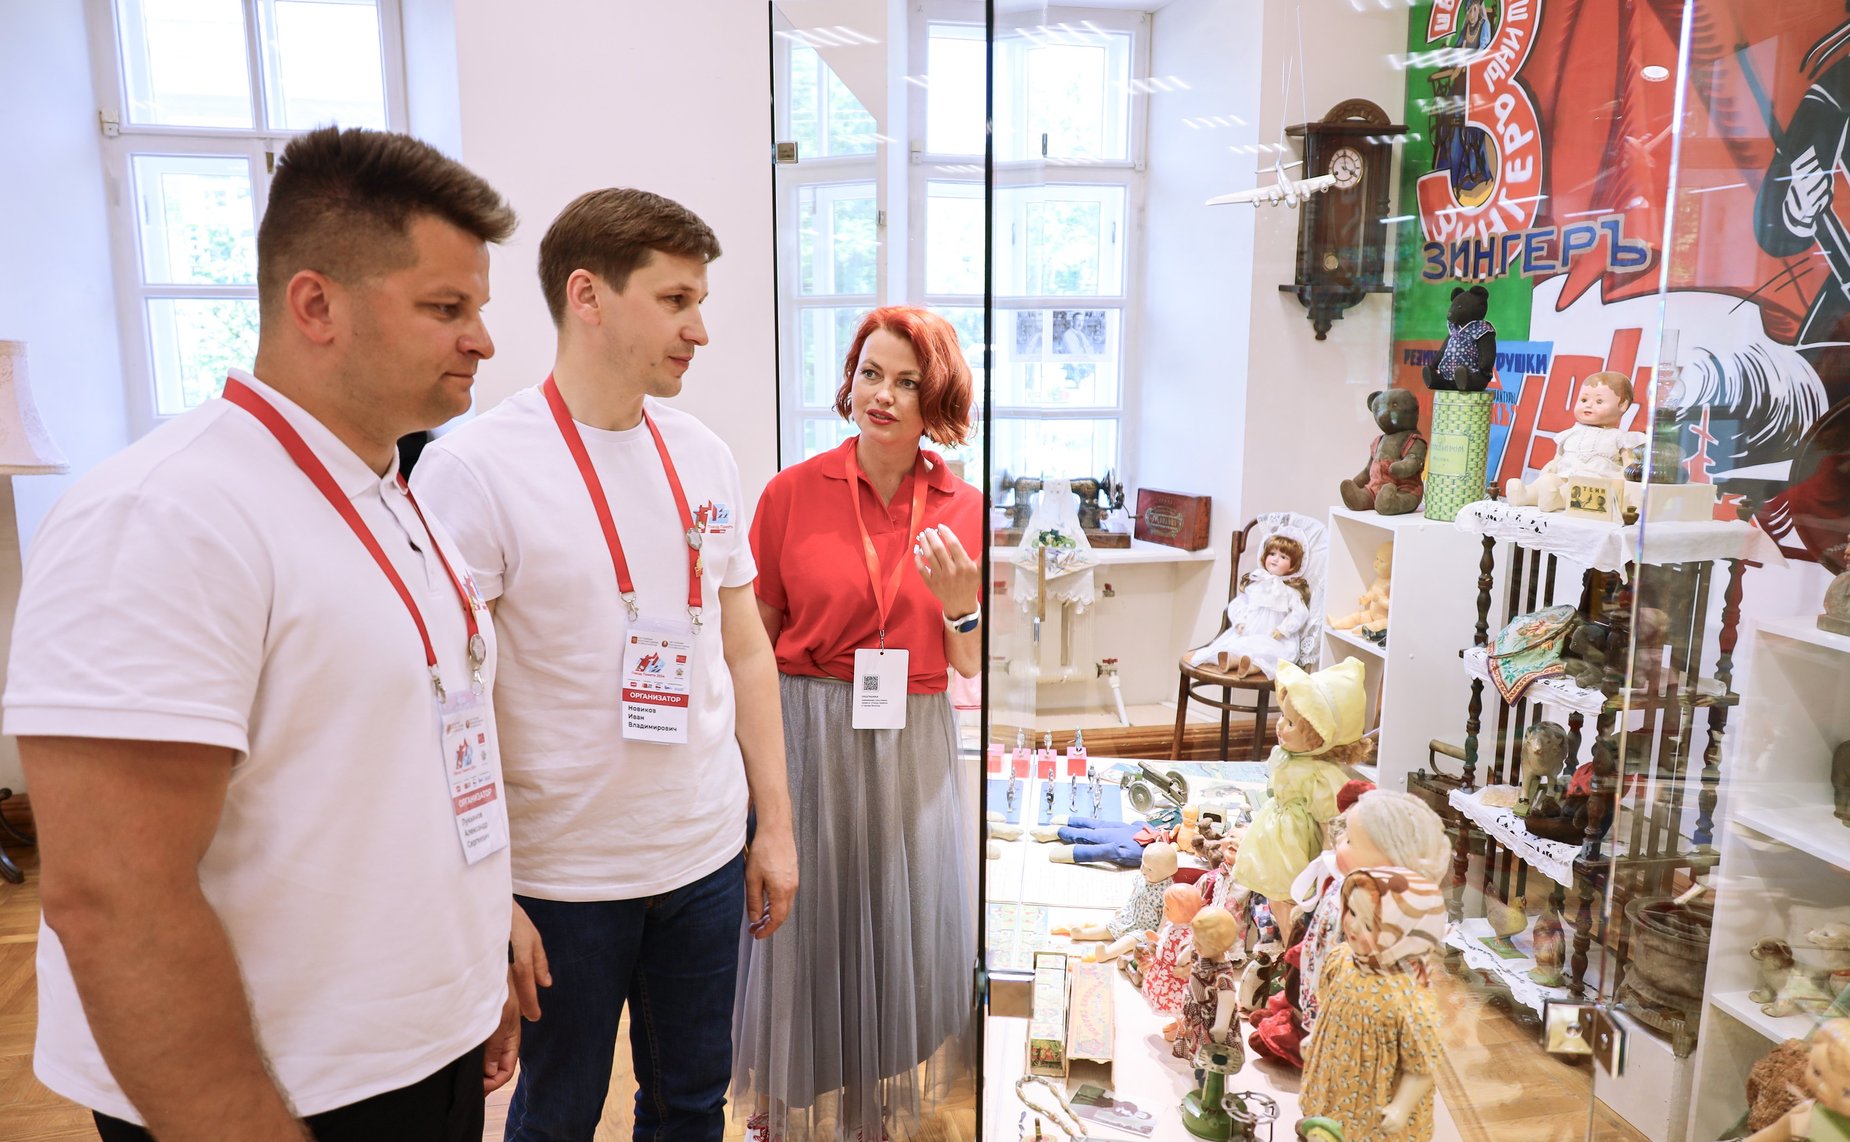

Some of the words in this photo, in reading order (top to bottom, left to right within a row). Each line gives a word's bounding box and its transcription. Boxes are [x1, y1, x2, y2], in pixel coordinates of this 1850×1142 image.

[1483, 0, 1530, 94] ШИНЫ
[1421, 216, 1651, 282] ЗИНГЕРЪ
[1495, 352, 1548, 374] РУШКИ
[630, 691, 681, 703] ОРГАНИЗАТОР
[628, 705, 657, 714] Новиков
[628, 721, 677, 731] Владимирович
